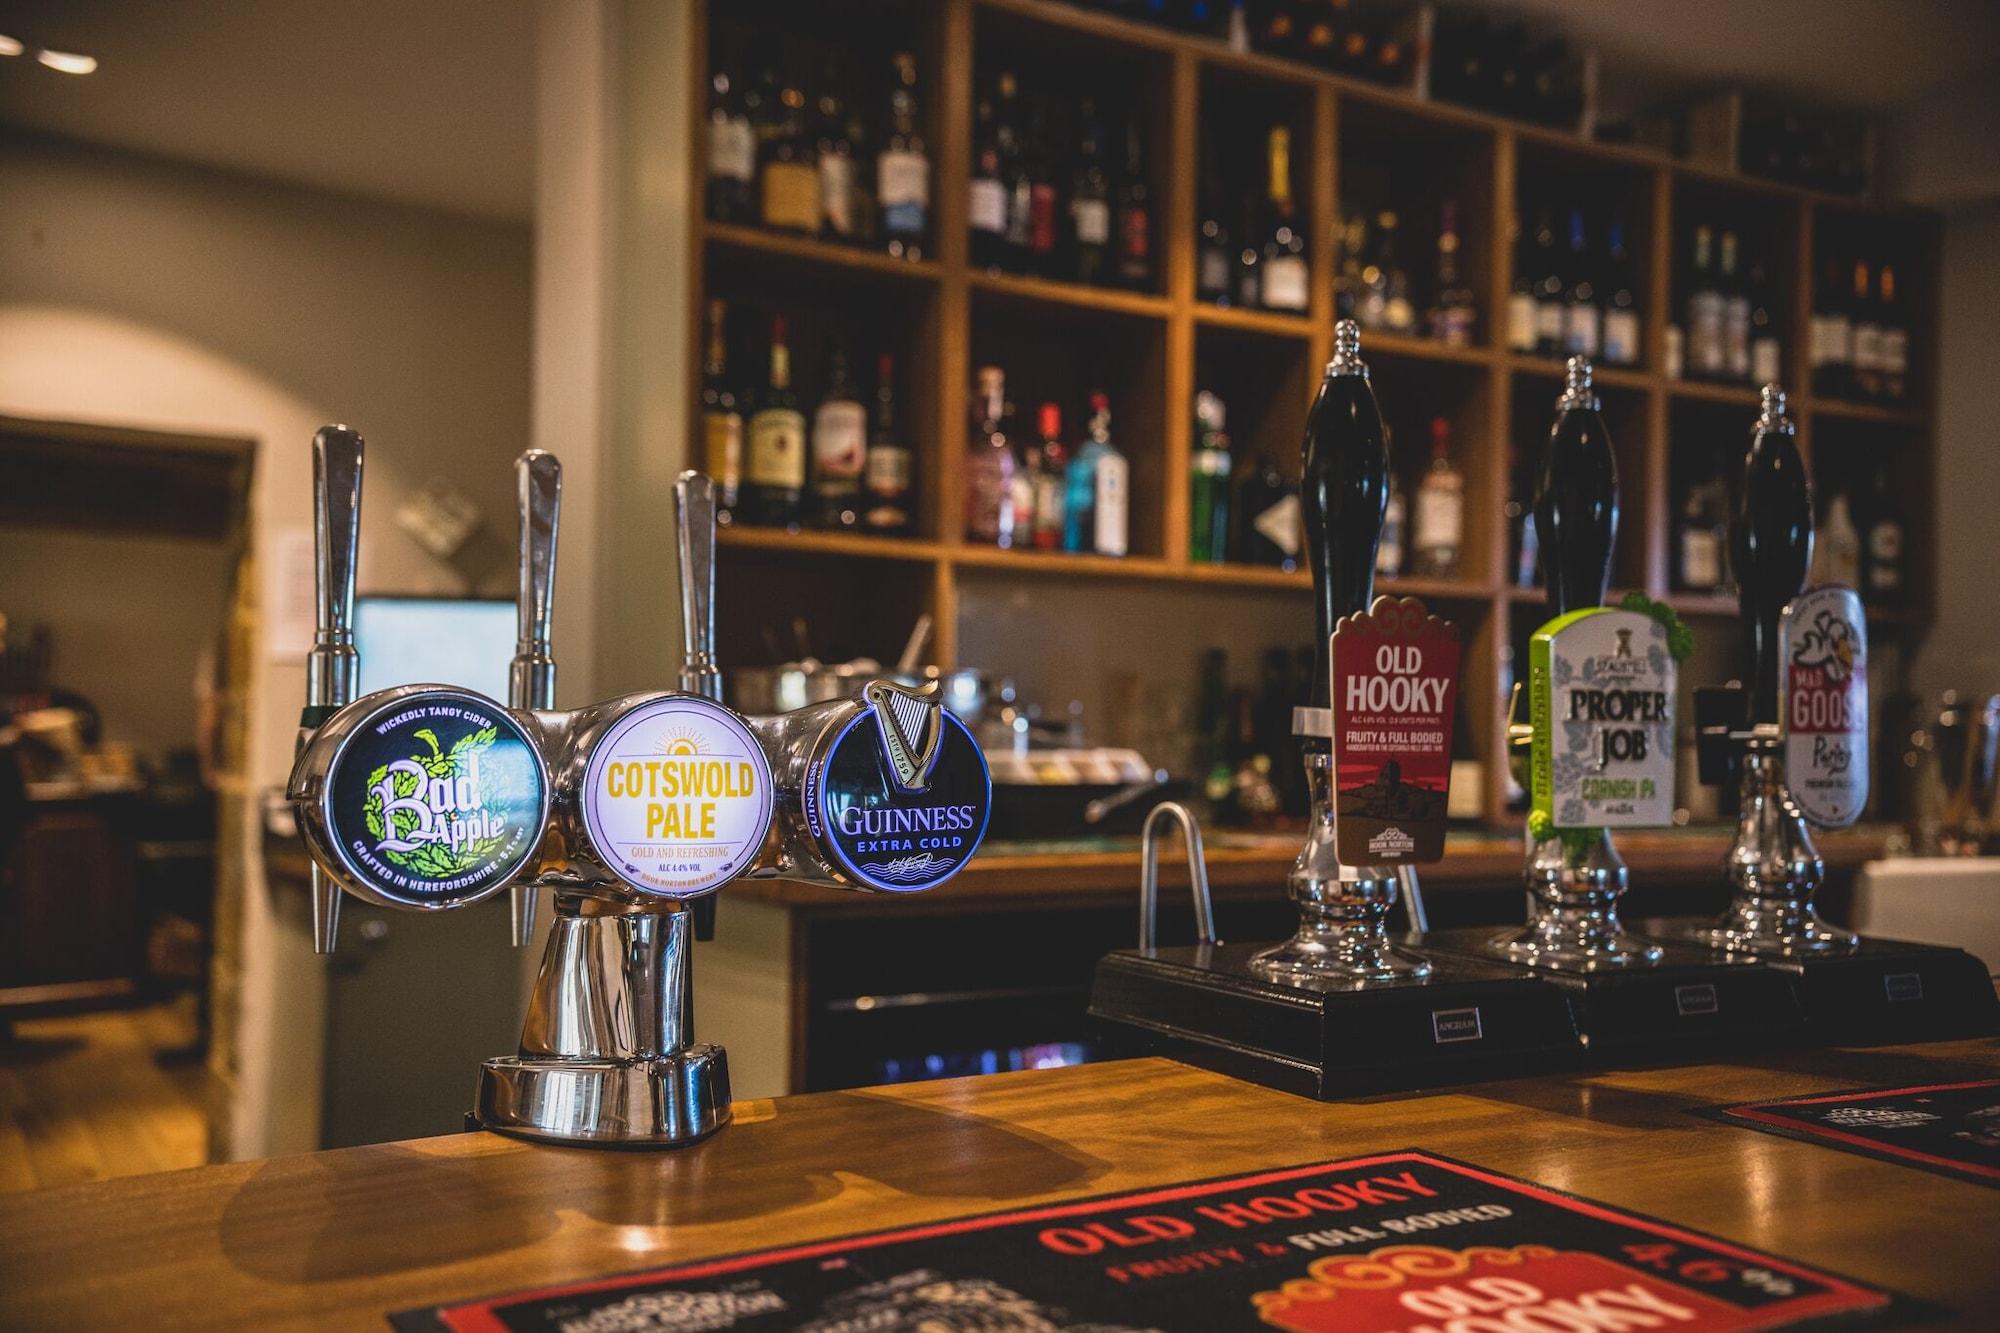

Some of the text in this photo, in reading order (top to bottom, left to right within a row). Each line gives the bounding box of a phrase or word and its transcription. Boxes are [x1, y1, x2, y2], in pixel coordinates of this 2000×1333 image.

[1376, 644, 1422, 674] OLD
[1346, 675, 1450, 713] HOOKY
[1570, 689, 1667, 720] PROPER
[1793, 690, 1855, 727] GOOS
[376, 706, 492, 735] WICKEDLY TANGY CIDER
[1346, 731, 1443, 744] FRUITY & FULL BODIED
[895, 752, 909, 775] 1759
[1601, 729, 1647, 769] JOB
[607, 761, 754, 799] COTSWOLD
[806, 761, 821, 837] GUINNESS
[371, 750, 482, 851] Bad
[431, 810, 505, 852] Apple
[646, 803, 716, 839] PALE
[632, 846, 729, 858] GOLD AND REFRESHING
[857, 836, 962, 853] EXTRA COLD
[353, 840, 395, 880] CRAFTED
[394, 874, 407, 887] IN
[409, 861, 499, 892] HEREFORDSHIRE
[658, 863, 671, 872] ALC
[689, 863, 702, 872] VOL
[1038, 1171, 1439, 1255] OLD HOOKY
[1106, 1246, 1245, 1284] FRUITY
[1287, 1225, 1388, 1251] FULL
[1380, 1204, 1513, 1234] BODIED
[1388, 1284, 1695, 1333] OOKY
[1400, 1277, 1543, 1320] OLD
